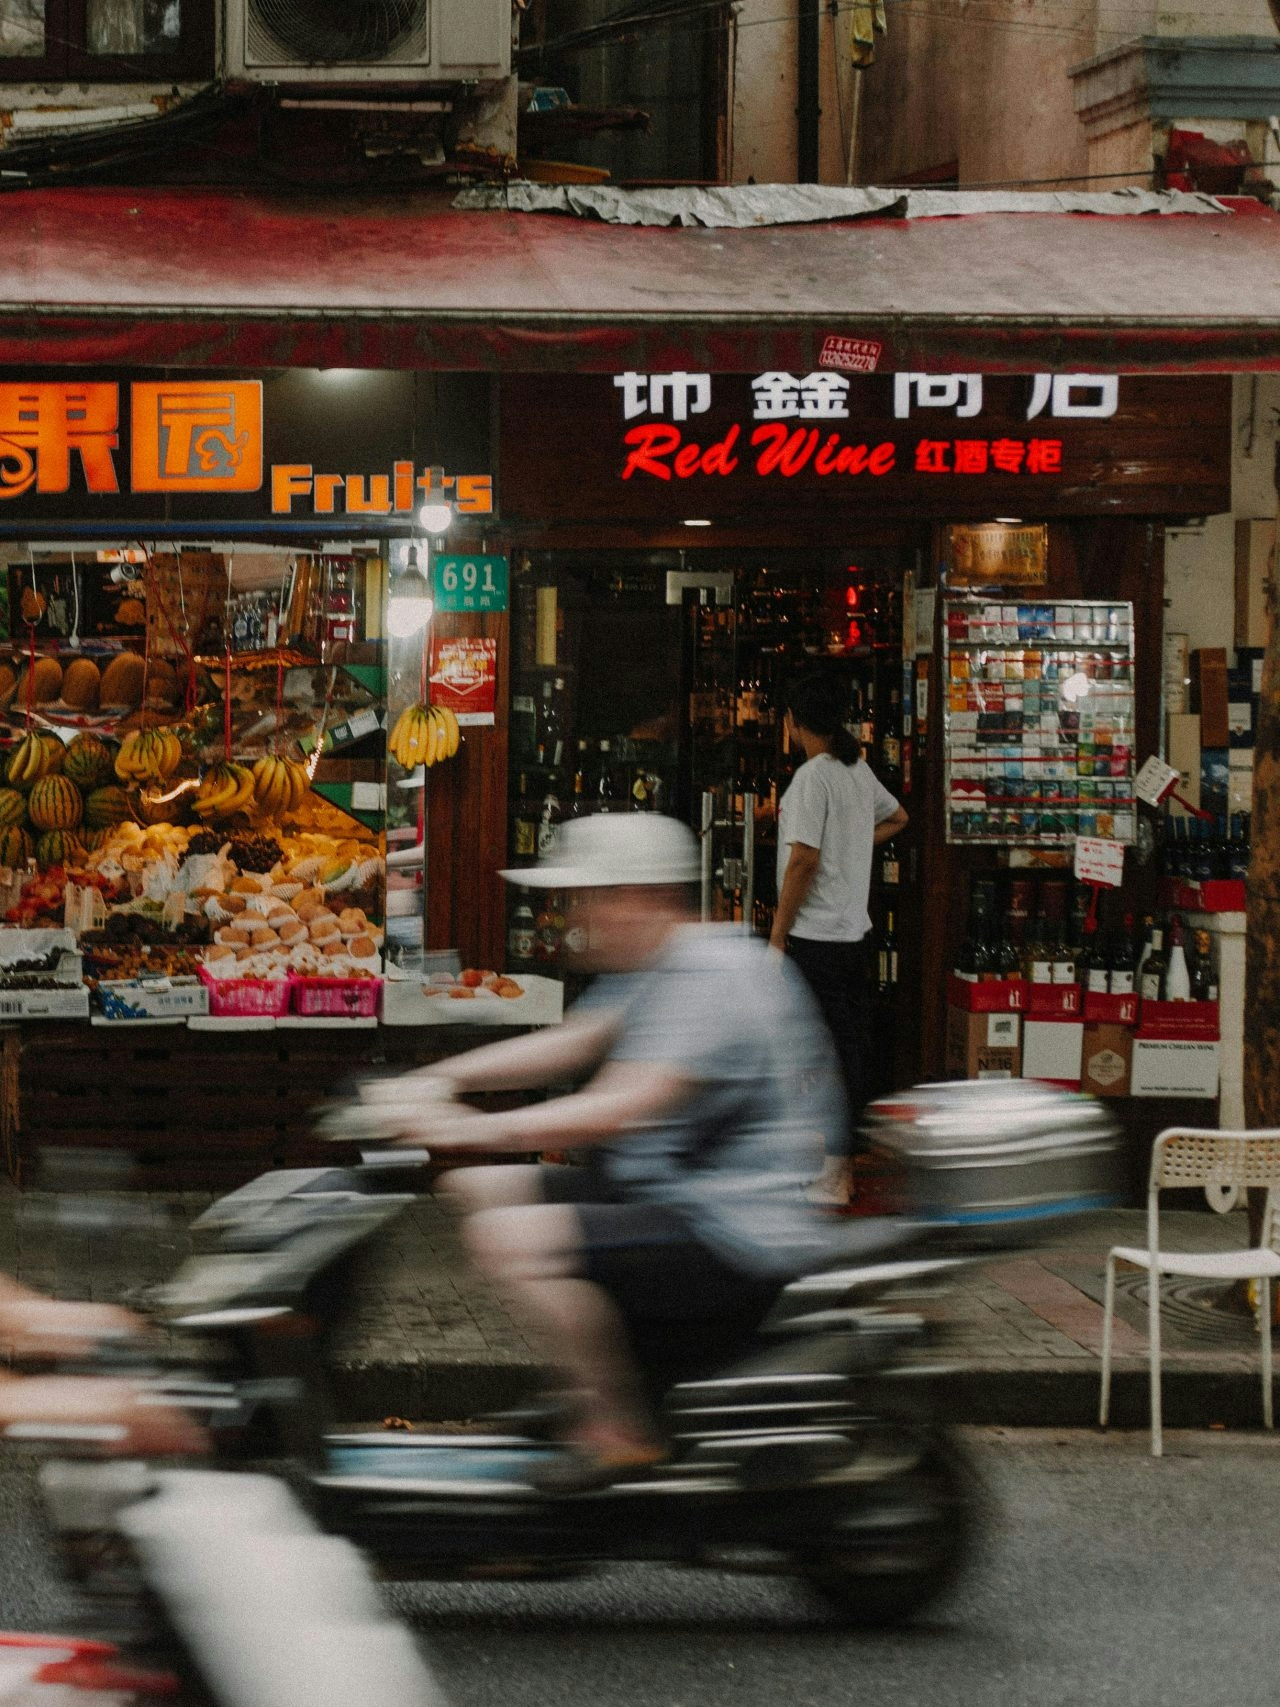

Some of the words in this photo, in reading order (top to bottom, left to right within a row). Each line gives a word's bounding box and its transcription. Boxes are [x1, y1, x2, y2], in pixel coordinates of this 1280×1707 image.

[622, 423, 740, 481] Red
[750, 422, 896, 478] Wine
[914, 438, 1063, 475] 红酒专柜
[271, 460, 494, 514] Fruits
[442, 561, 496, 593] 691
